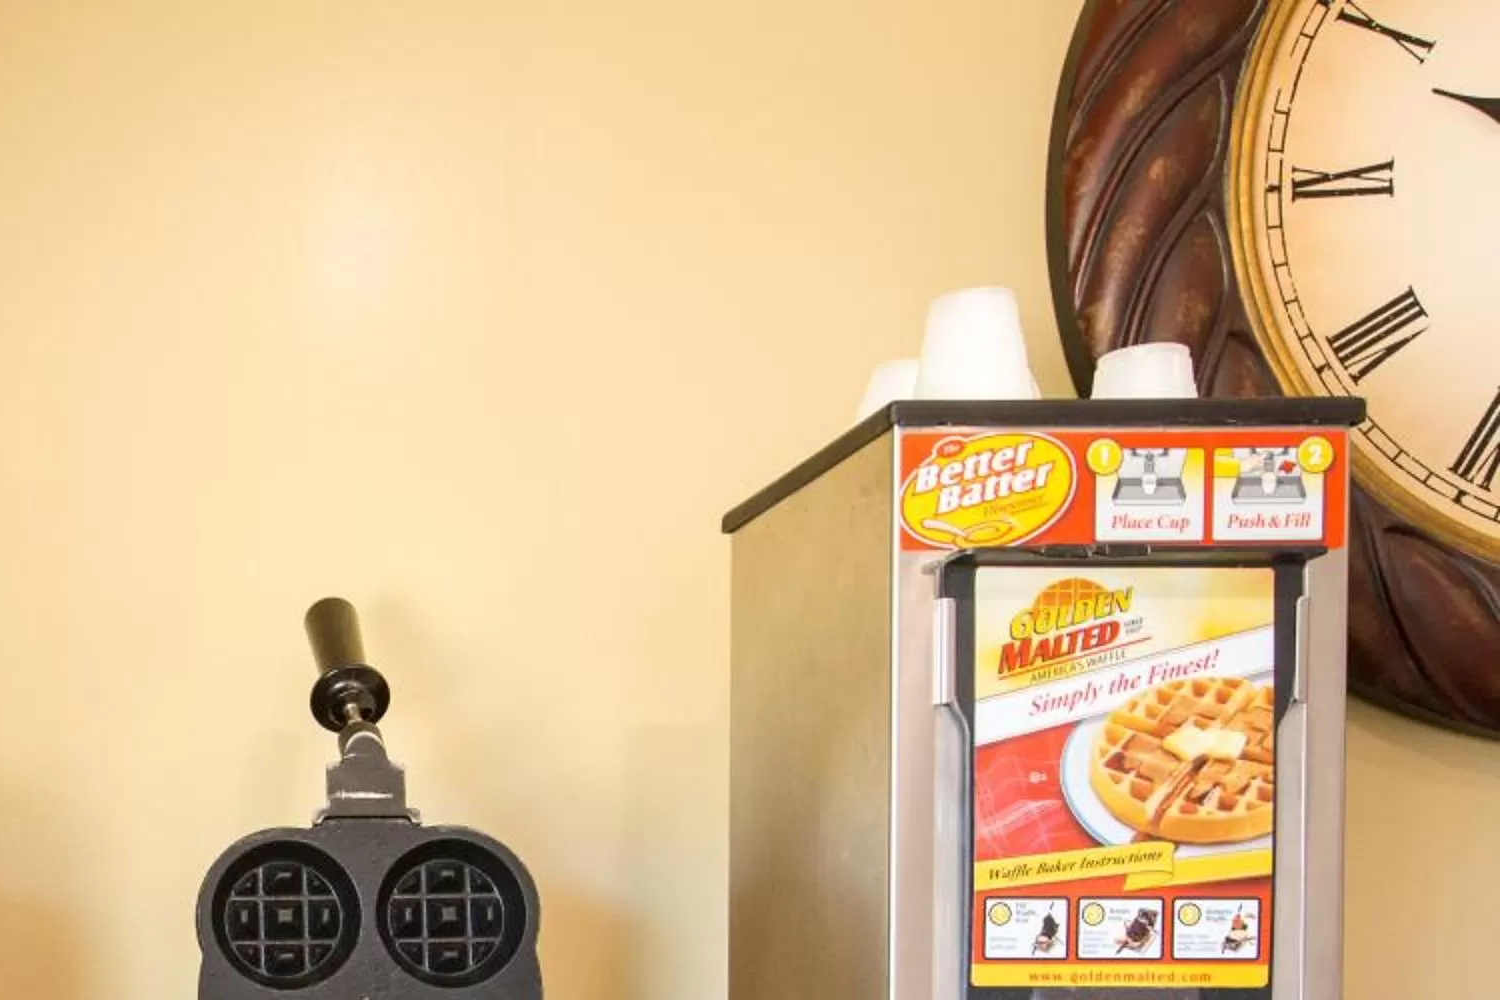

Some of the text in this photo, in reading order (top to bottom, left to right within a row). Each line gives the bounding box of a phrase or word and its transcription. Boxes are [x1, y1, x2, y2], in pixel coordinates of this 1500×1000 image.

[1335, 0, 1437, 64] X
[915, 441, 1034, 493] Better
[1100, 449, 1109, 465] 1
[1308, 445, 1323, 464] 2
[936, 463, 1053, 514] Batter
[1111, 513, 1190, 533] Place Cup
[1227, 512, 1311, 530] Push & Fill
[1010, 585, 1134, 641] GOLDEN
[998, 620, 1120, 674] MALTED
[1086, 649, 1127, 670] WAFFLE
[1028, 648, 1221, 717] Simply the Finest!
[988, 850, 1164, 881] Waffle Baker Instructions
[1028, 970, 1212, 985] www.goldenmalted.com
